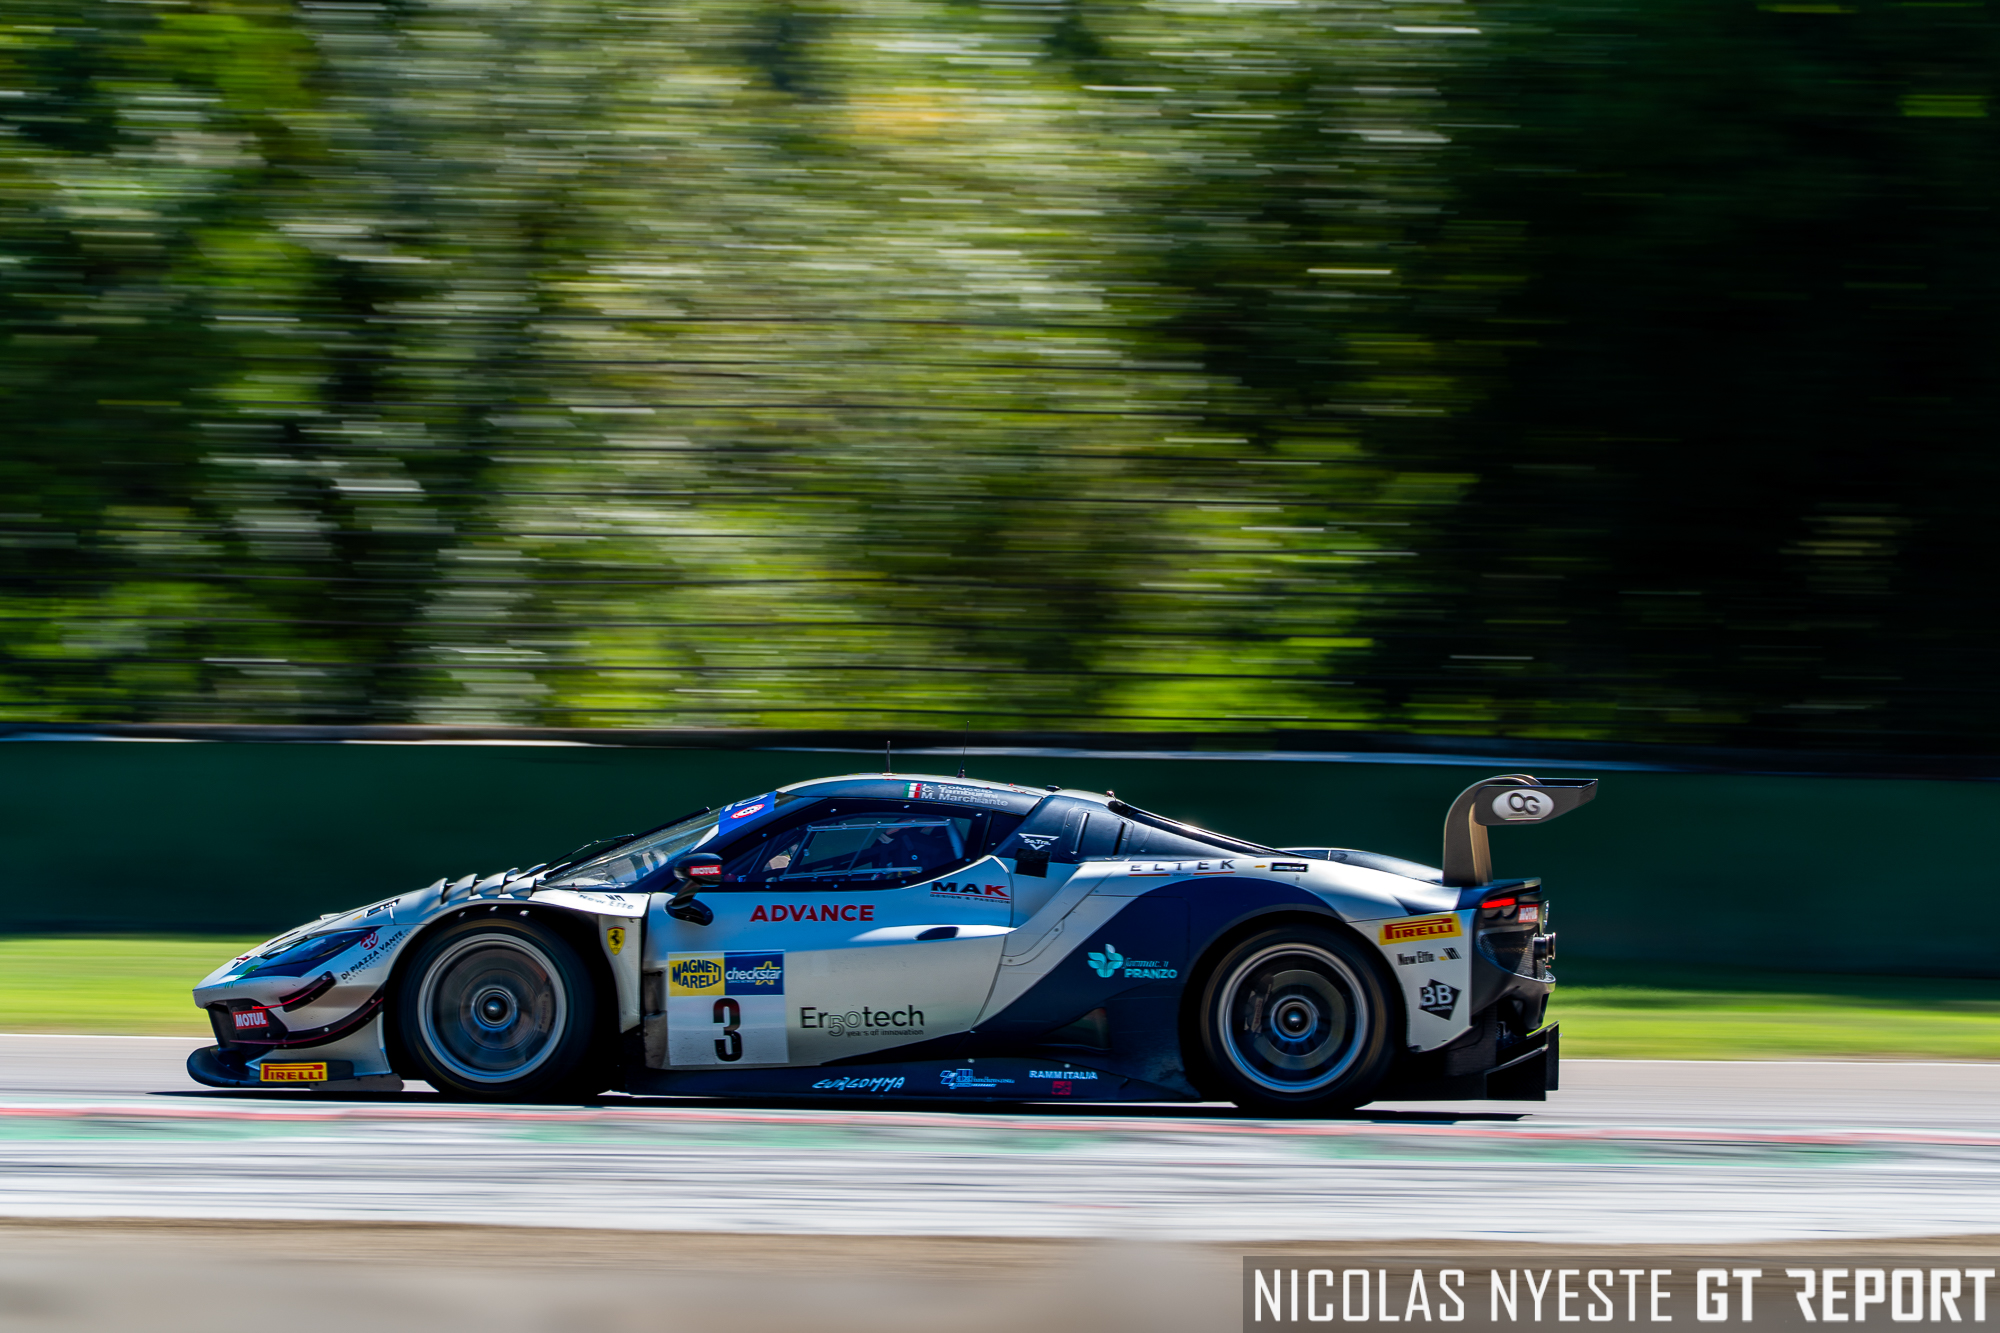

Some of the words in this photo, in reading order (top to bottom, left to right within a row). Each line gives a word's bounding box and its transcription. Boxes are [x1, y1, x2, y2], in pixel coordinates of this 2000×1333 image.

[938, 794, 1009, 807] Marchiante
[691, 866, 720, 875] MOTUL
[1130, 860, 1235, 872] ELTEK
[931, 882, 1010, 897] MAK
[750, 904, 875, 922] ADVANCE
[1383, 918, 1455, 940] PIRELLI
[341, 970, 351, 981] DI
[349, 950, 380, 973] PIAZZA
[378, 930, 403, 951] VANTE
[1397, 953, 1416, 965] New
[725, 967, 783, 980] checkstar
[1124, 968, 1178, 979] PRANZO
[235, 1012, 267, 1027] MOTUL
[713, 997, 742, 1062] 3
[263, 1064, 324, 1080] PIRELLI
[1029, 1070, 1062, 1079] RAMM
[1063, 1071, 1098, 1080] ITALIA
